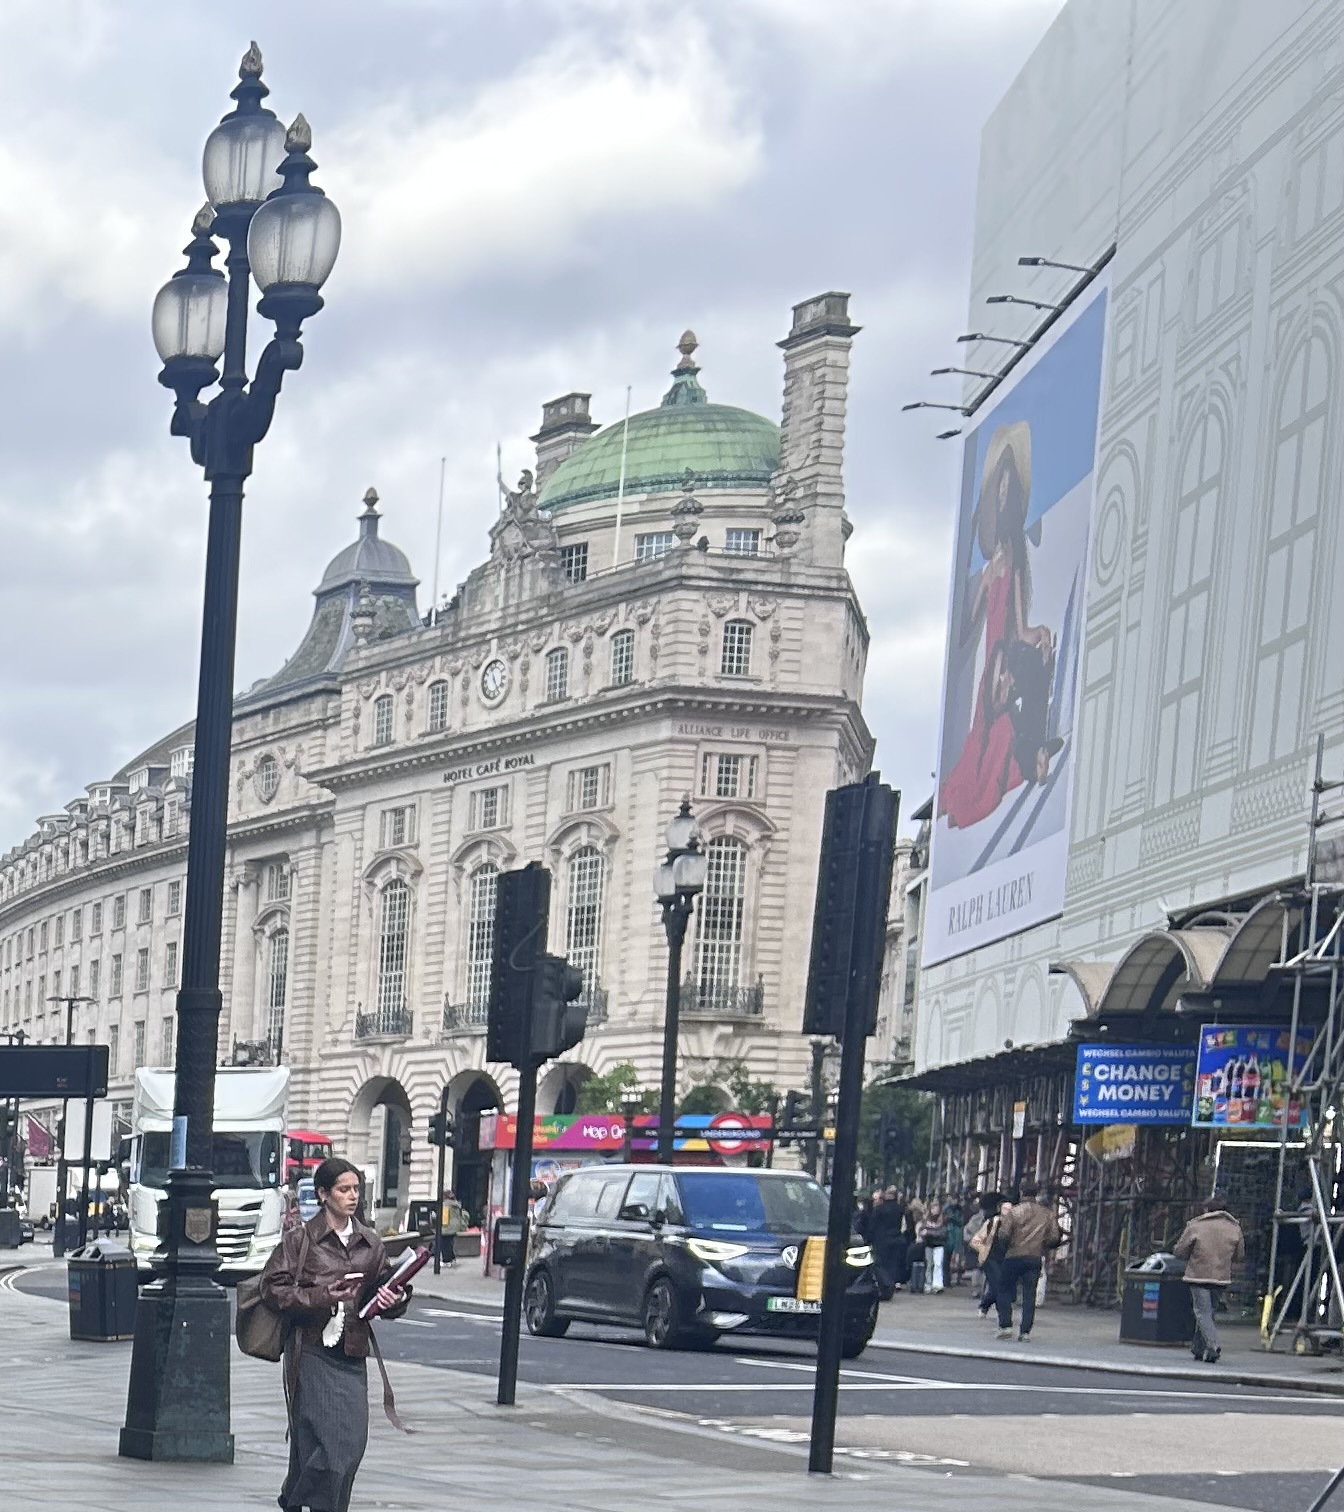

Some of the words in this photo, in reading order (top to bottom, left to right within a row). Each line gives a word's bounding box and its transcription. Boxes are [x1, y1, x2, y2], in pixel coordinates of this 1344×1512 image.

[678, 724, 723, 737] ALLIANCE
[731, 727, 750, 739] LIFE
[759, 728, 790, 740] OFFICE
[443, 767, 472, 783] HOTEL
[476, 757, 500, 776] CAFÉ
[504, 753, 535, 769] ROYAL
[947, 894, 984, 936] RALPH
[987, 871, 1034, 921] LAUREN
[1094, 1064, 1181, 1081] CHANGE
[1098, 1084, 1174, 1102] MONEY
[700, 1129, 761, 1138] UNDERGROUND
